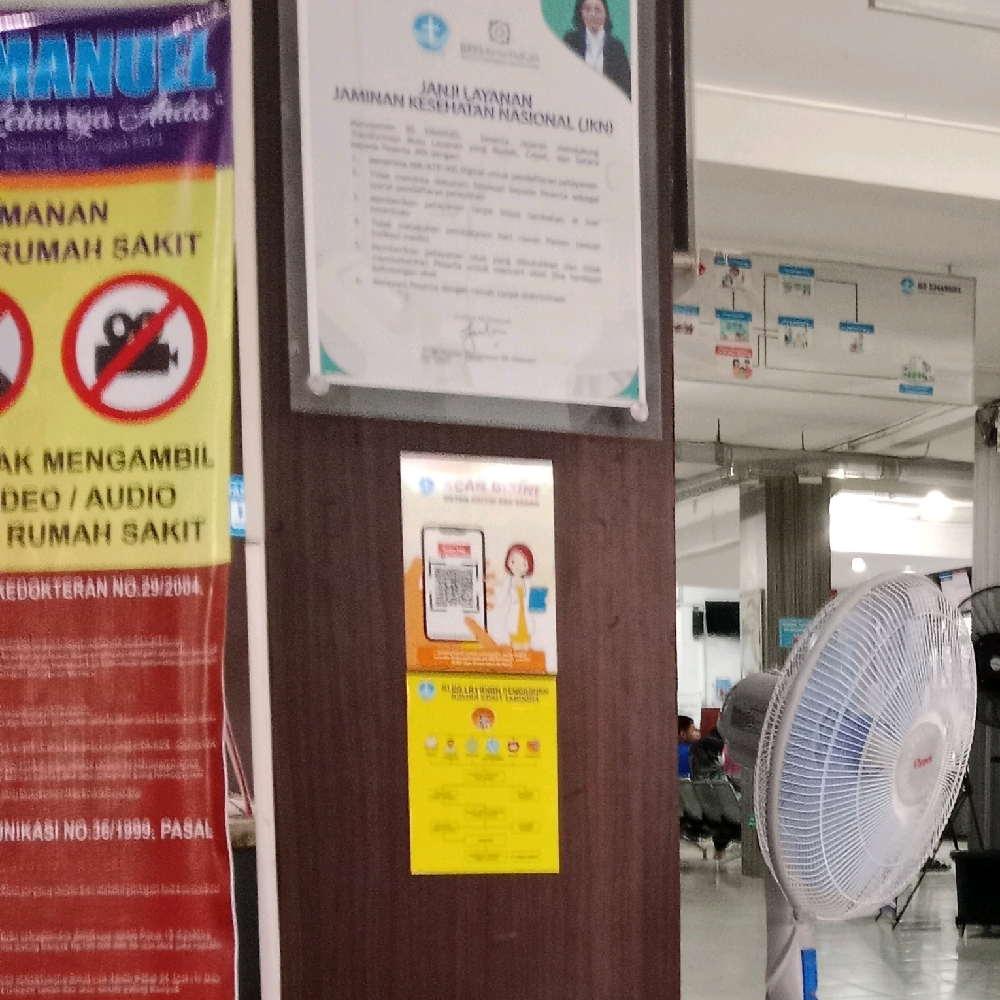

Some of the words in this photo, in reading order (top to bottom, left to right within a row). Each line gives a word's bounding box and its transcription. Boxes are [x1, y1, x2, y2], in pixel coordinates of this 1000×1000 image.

[422, 79, 459, 98] JANJI
[460, 86, 532, 109] LAYANAN
[333, 84, 405, 107] JAMINAN
[409, 95, 494, 120] KESEHATAN
[500, 105, 574, 131] NASIONAL
[579, 115, 613, 135] (JKN)
[0, 200, 109, 227] MANAN
[112, 232, 201, 260] SAKIT
[43, 441, 215, 474] MENGAMBIL
[0, 486, 61, 513] DEO
[85, 484, 177, 511] AUDIO
[7, 520, 112, 548] RUMAH
[122, 518, 206, 545] SAKIT
[0, 817, 59, 842] NIKASI
[161, 816, 214, 840] PASAL
